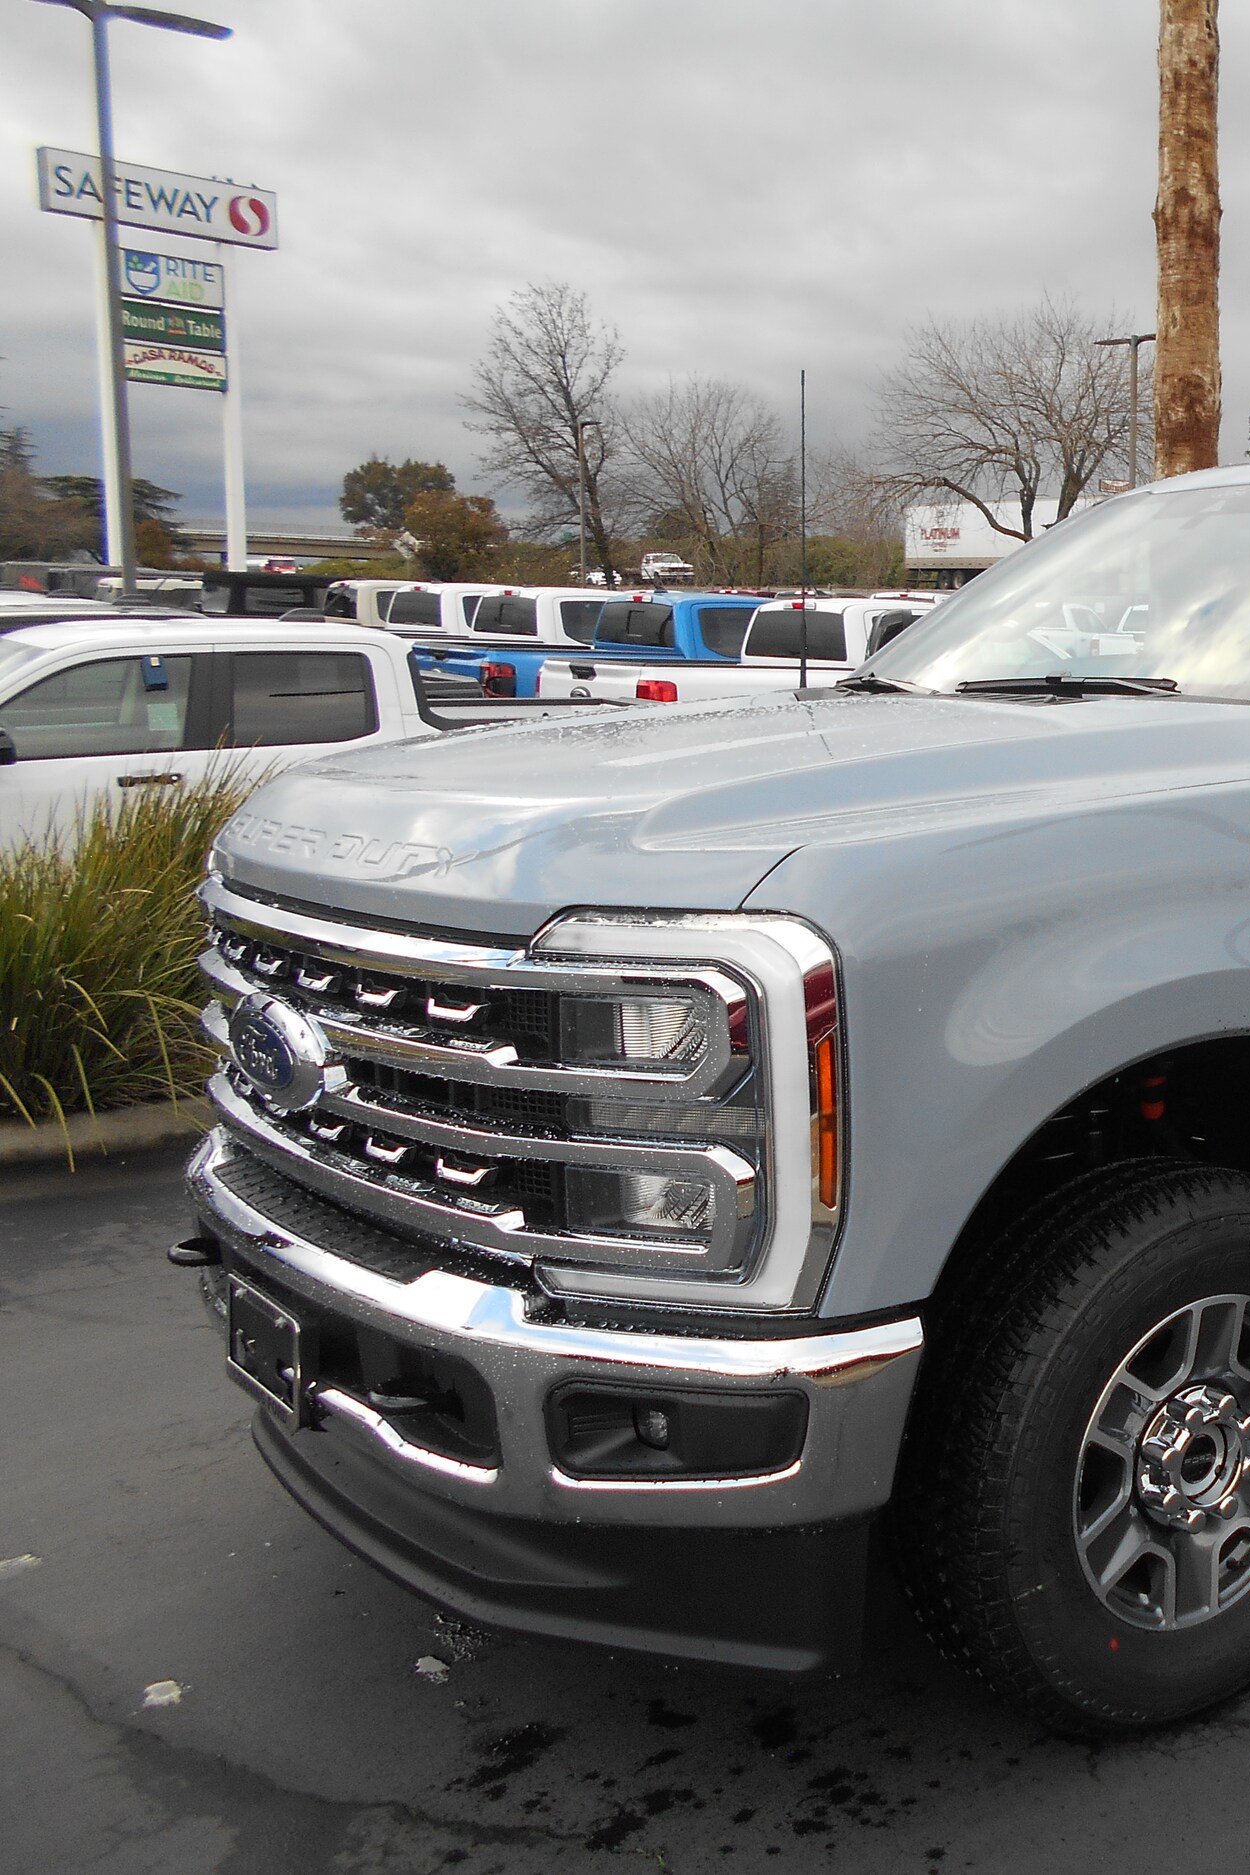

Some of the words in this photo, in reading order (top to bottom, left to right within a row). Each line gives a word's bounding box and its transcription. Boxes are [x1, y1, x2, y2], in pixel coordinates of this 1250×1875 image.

[166, 256, 216, 283] RITE
[165, 280, 205, 302] AID
[122, 309, 165, 332] Round
[187, 319, 222, 339] Table
[224, 813, 328, 859] SUPER
[332, 833, 480, 878] DUTY
